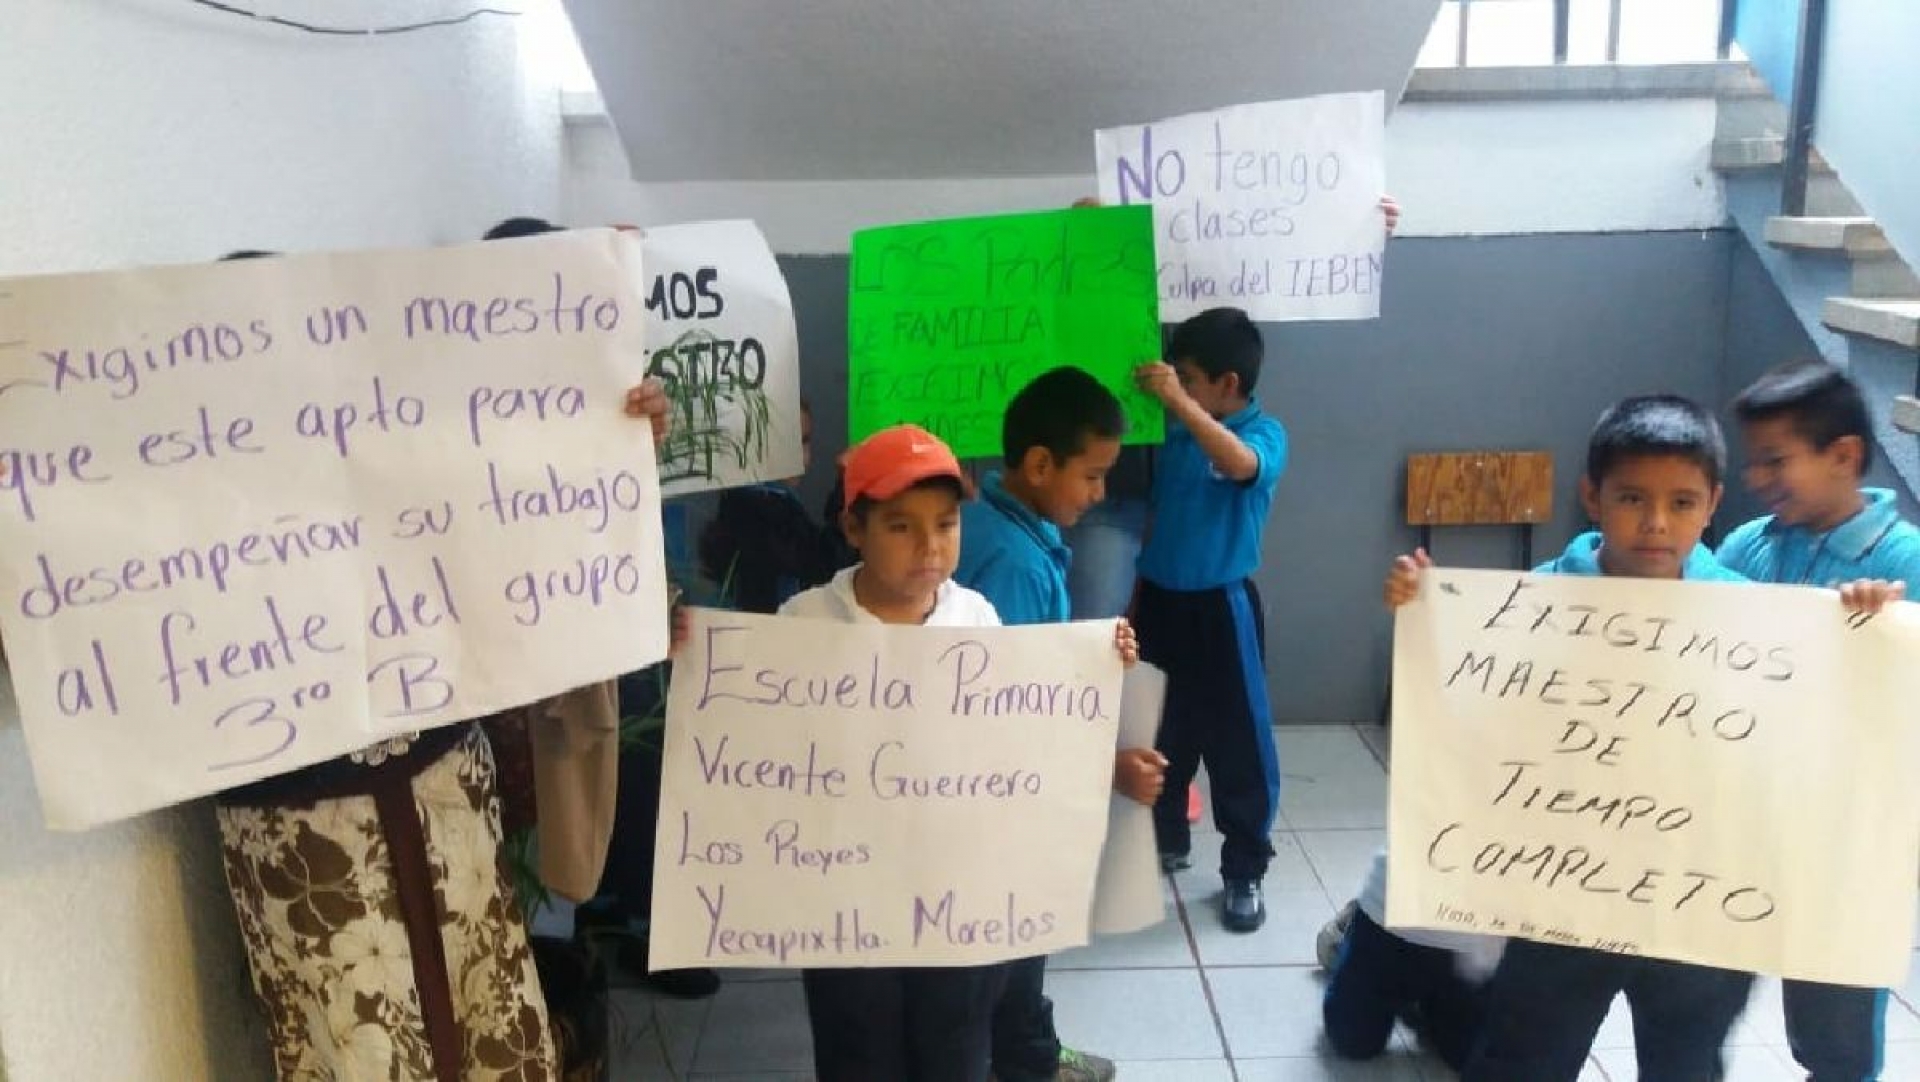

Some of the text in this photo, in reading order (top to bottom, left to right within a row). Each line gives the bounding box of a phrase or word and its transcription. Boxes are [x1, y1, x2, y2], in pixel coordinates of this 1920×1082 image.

[1214, 118, 1340, 205] tengo
[1169, 199, 1295, 244] clases
[306, 302, 366, 346] un
[404, 275, 619, 338] maestro
[644, 265, 723, 321] MOS
[1230, 259, 1270, 297] del
[893, 306, 1046, 348] FAMILIA
[644, 338, 766, 398] STRO
[0, 376, 587, 521] que este apto para
[20, 462, 640, 620] desempeñar su trabajo
[57, 555, 640, 717] al frente del grupo
[1484, 578, 1794, 682] EXIGIMOS
[697, 626, 1109, 721] Escuela Primaria
[1447, 651, 1758, 742] MAESTRO
[693, 735, 1041, 800] Vicente Guerrero
[1552, 719, 1632, 766] DE
[1492, 761, 1695, 832] TIEMPO
[678, 811, 870, 873] Los Reyes
[1428, 822, 1775, 924] COMPLETO
[912, 889, 1056, 947] Morelos
